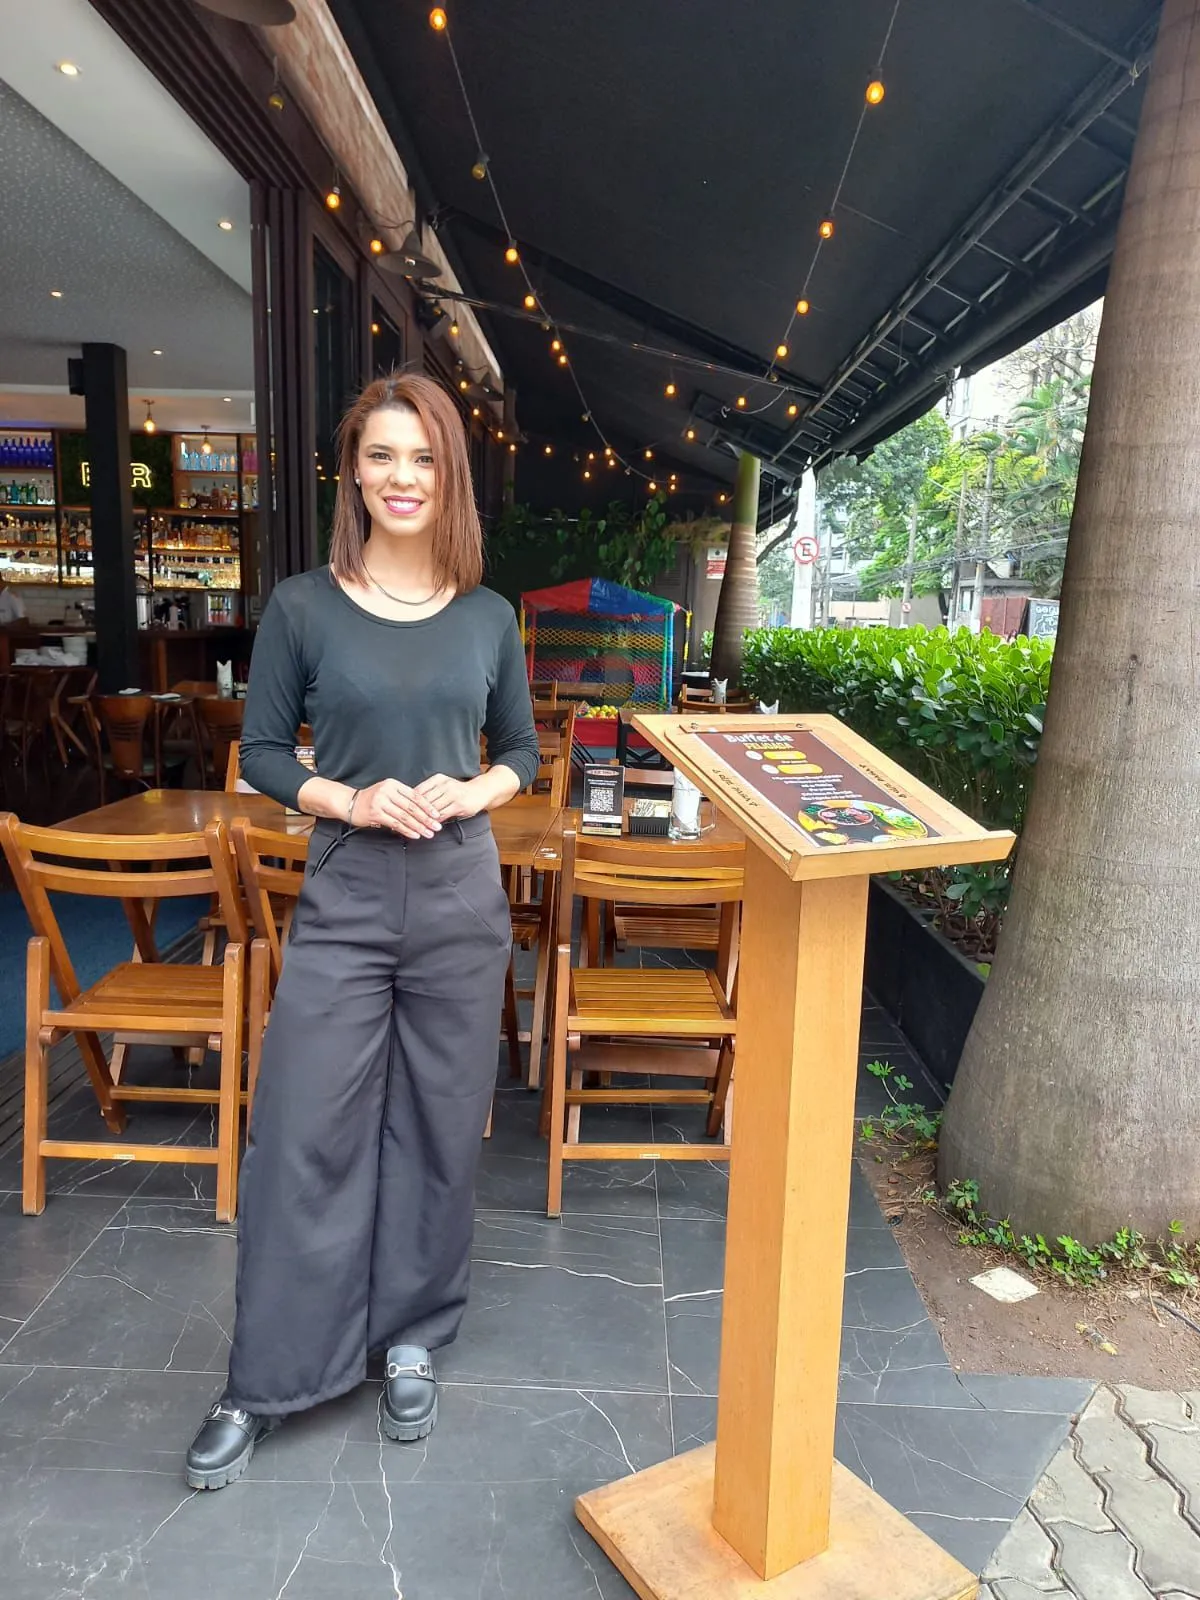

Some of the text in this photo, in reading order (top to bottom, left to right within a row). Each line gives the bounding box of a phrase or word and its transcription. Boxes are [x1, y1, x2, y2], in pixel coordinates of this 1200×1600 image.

[802, 543, 811, 556] E
[723, 733, 795, 743] Buffet de
